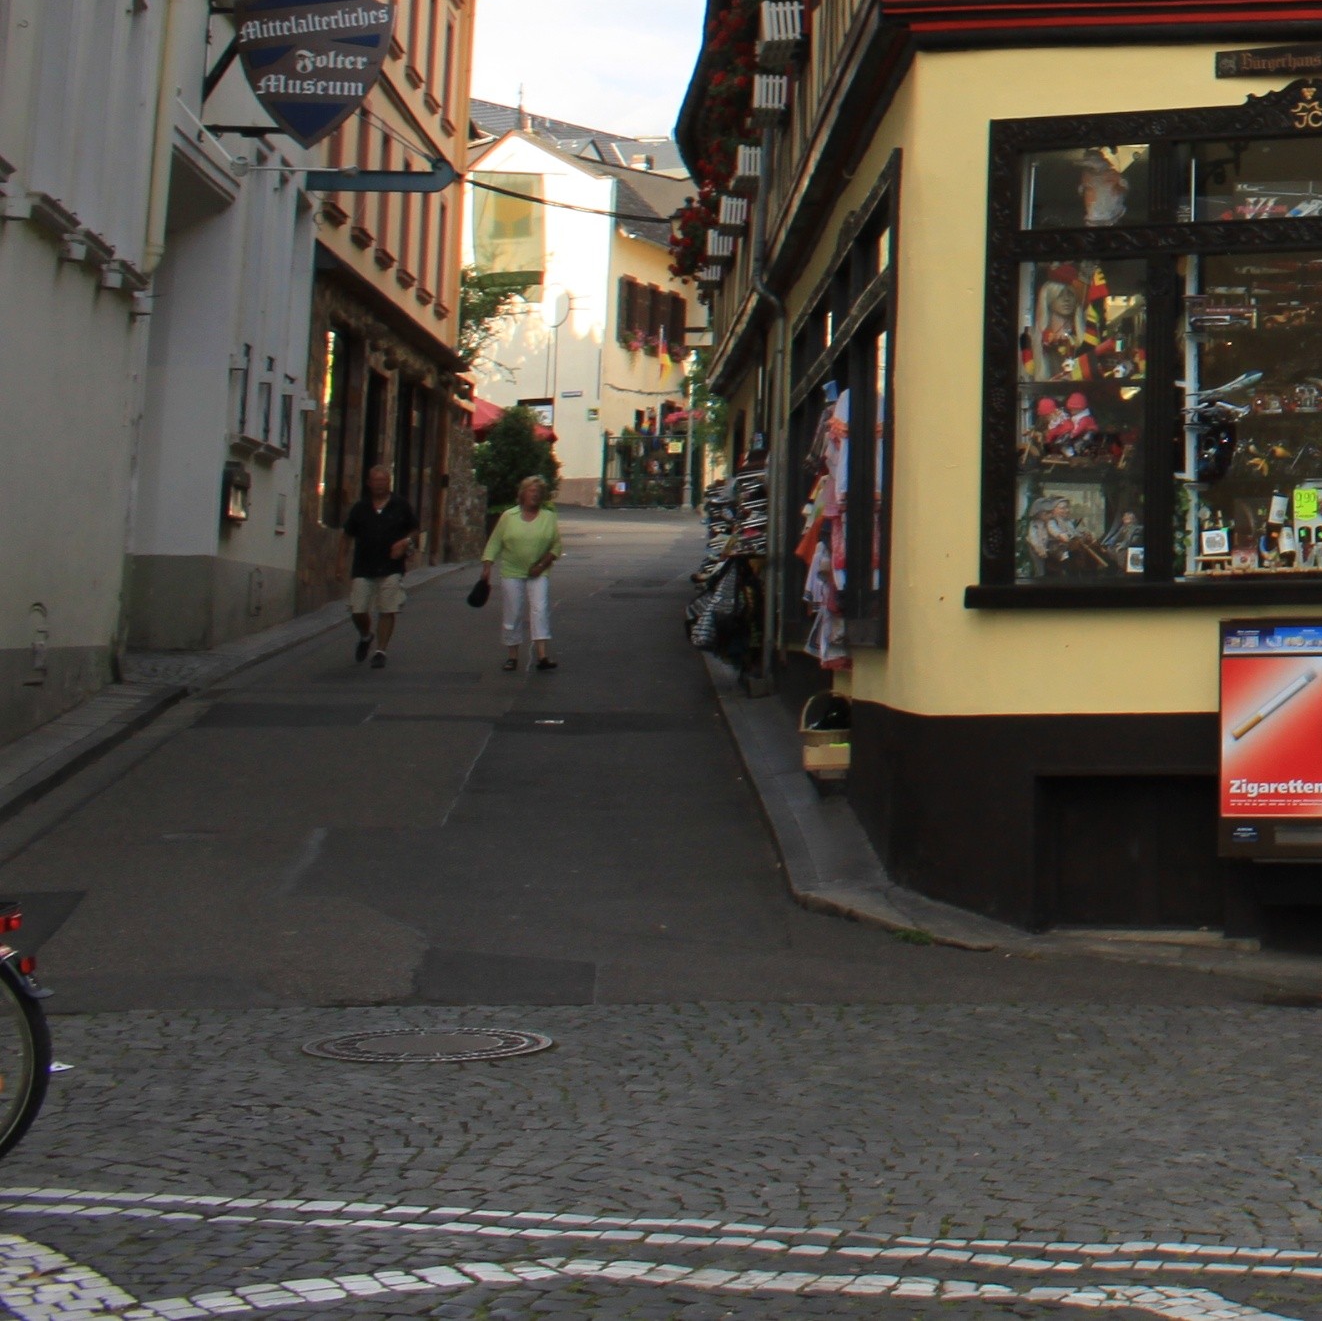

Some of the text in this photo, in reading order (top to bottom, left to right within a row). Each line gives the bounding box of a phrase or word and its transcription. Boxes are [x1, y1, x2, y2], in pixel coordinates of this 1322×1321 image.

[239, 6, 390, 43] Mittelalterliches
[296, 49, 368, 74] Folter
[256, 74, 364, 96] Museum
